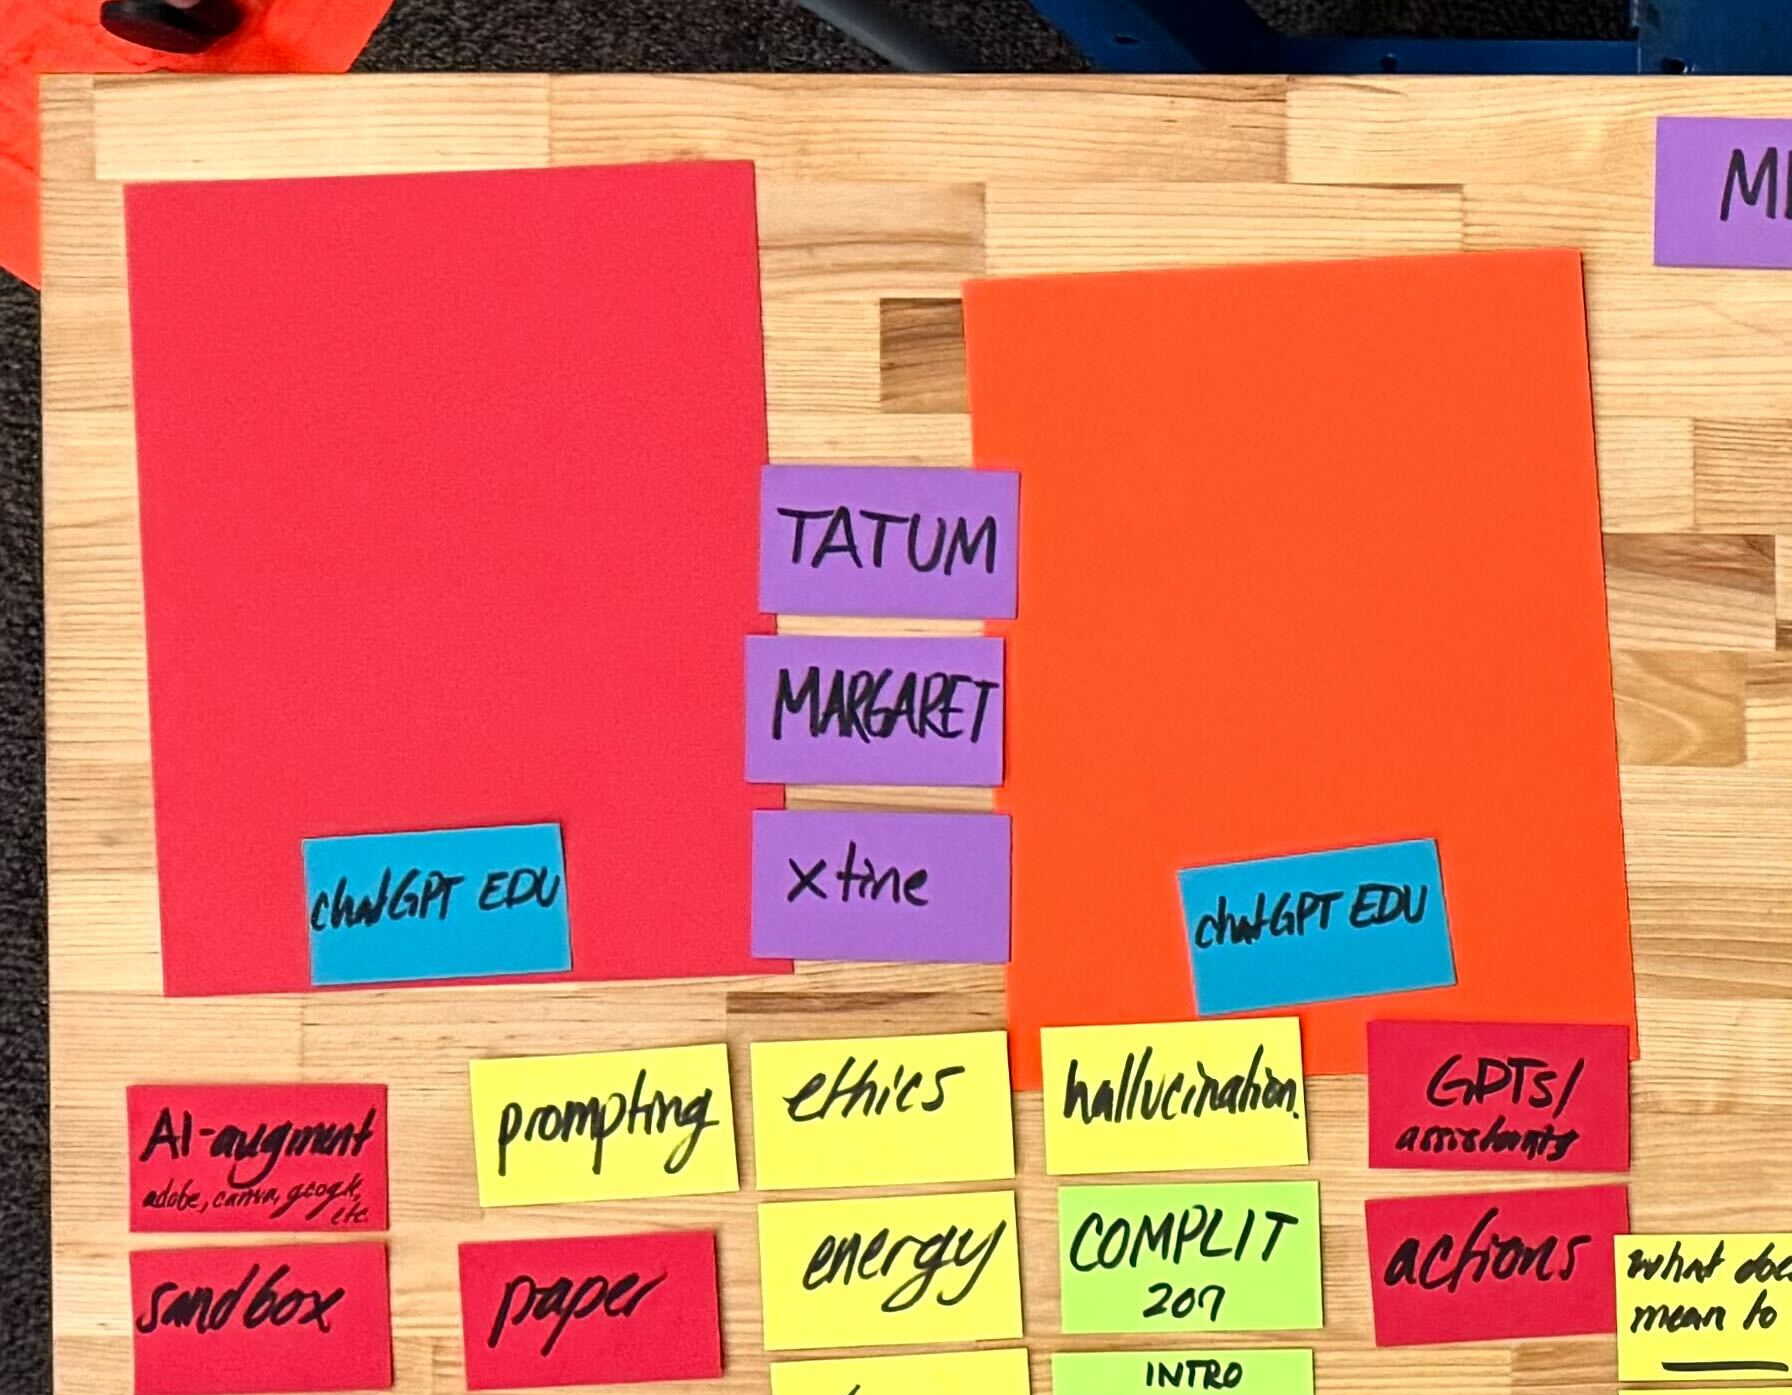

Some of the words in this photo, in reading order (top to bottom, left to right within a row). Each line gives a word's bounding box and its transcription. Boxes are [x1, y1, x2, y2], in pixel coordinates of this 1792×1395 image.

[778, 507, 996, 575] TATUM
[773, 667, 998, 743] MARGARET
[480, 869, 559, 910] EDU
[1350, 884, 1426, 927] EDU
[784, 1057, 964, 1121] ethics
[499, 1070, 718, 1176] prompting
[803, 1221, 1006, 1312] energy
[1070, 1205, 1298, 1271] COMPLIT
[1385, 1209, 1590, 1290] actions
[1628, 1240, 1724, 1283] what
[137, 1264, 346, 1334] sandbox
[489, 1273, 664, 1356] paper
[1143, 1283, 1225, 1321] 207
[1631, 1305, 1725, 1333] mean
[1743, 1289, 1777, 1329] to
[1147, 1360, 1242, 1389] INTRO
